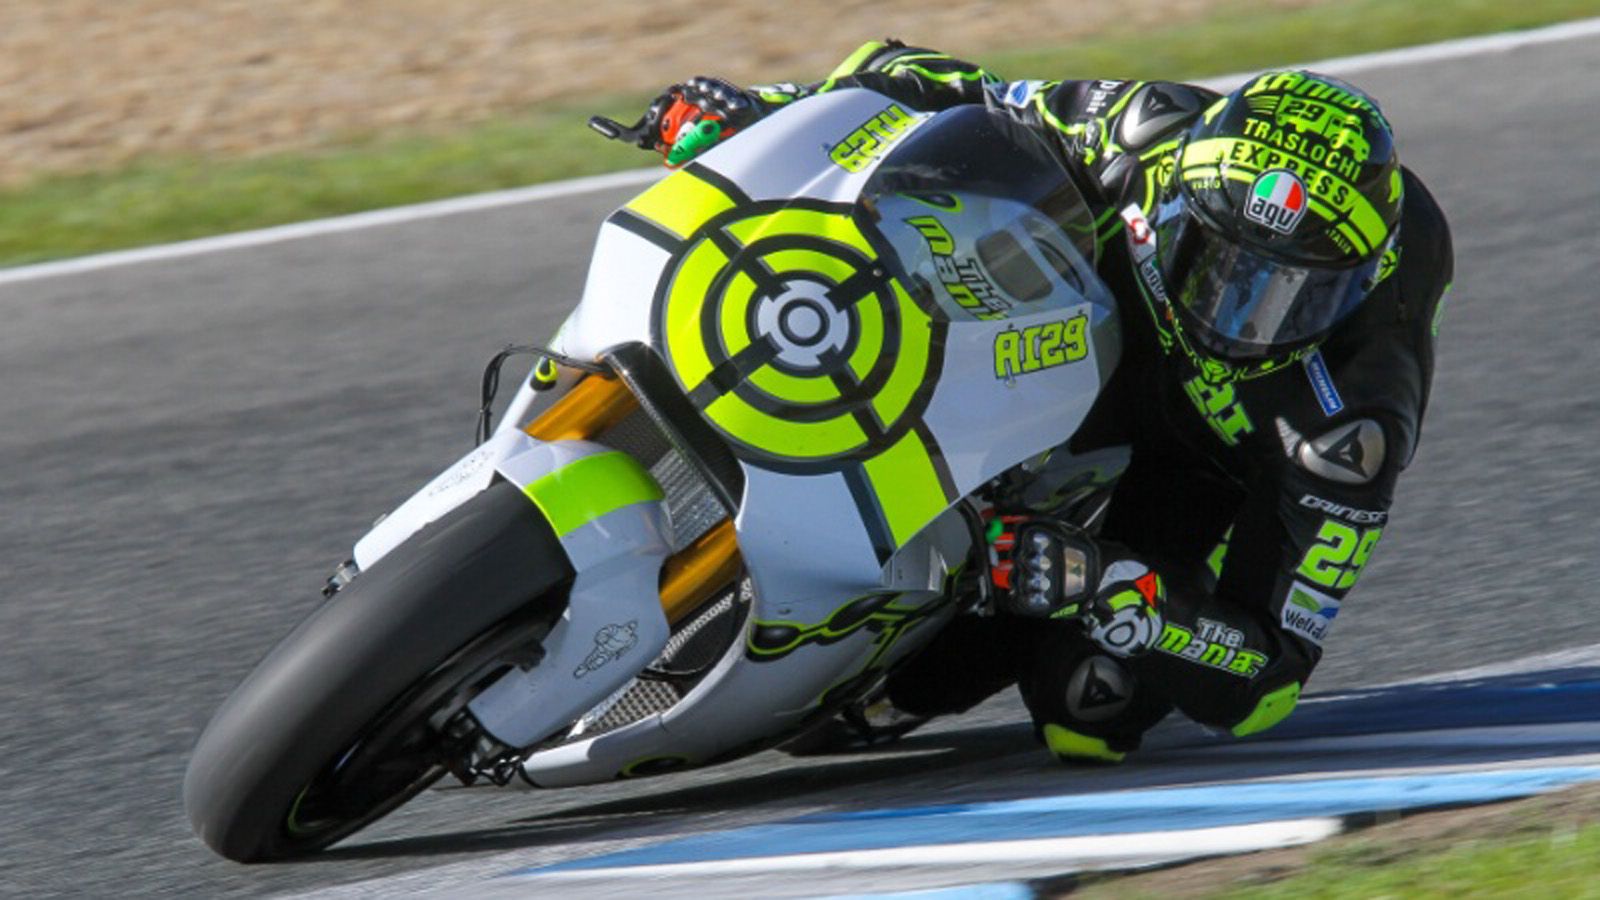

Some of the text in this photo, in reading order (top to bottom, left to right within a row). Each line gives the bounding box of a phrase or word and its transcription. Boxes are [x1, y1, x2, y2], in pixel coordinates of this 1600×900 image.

[1283, 100, 1327, 123] 29
[1229, 141, 1349, 206] EXPRESS
[1243, 117, 1361, 182] TRASLOCHI
[1251, 198, 1296, 226] agv
[993, 314, 1088, 379] AI29
[1296, 519, 1383, 589] 29
[1199, 618, 1245, 648] The
